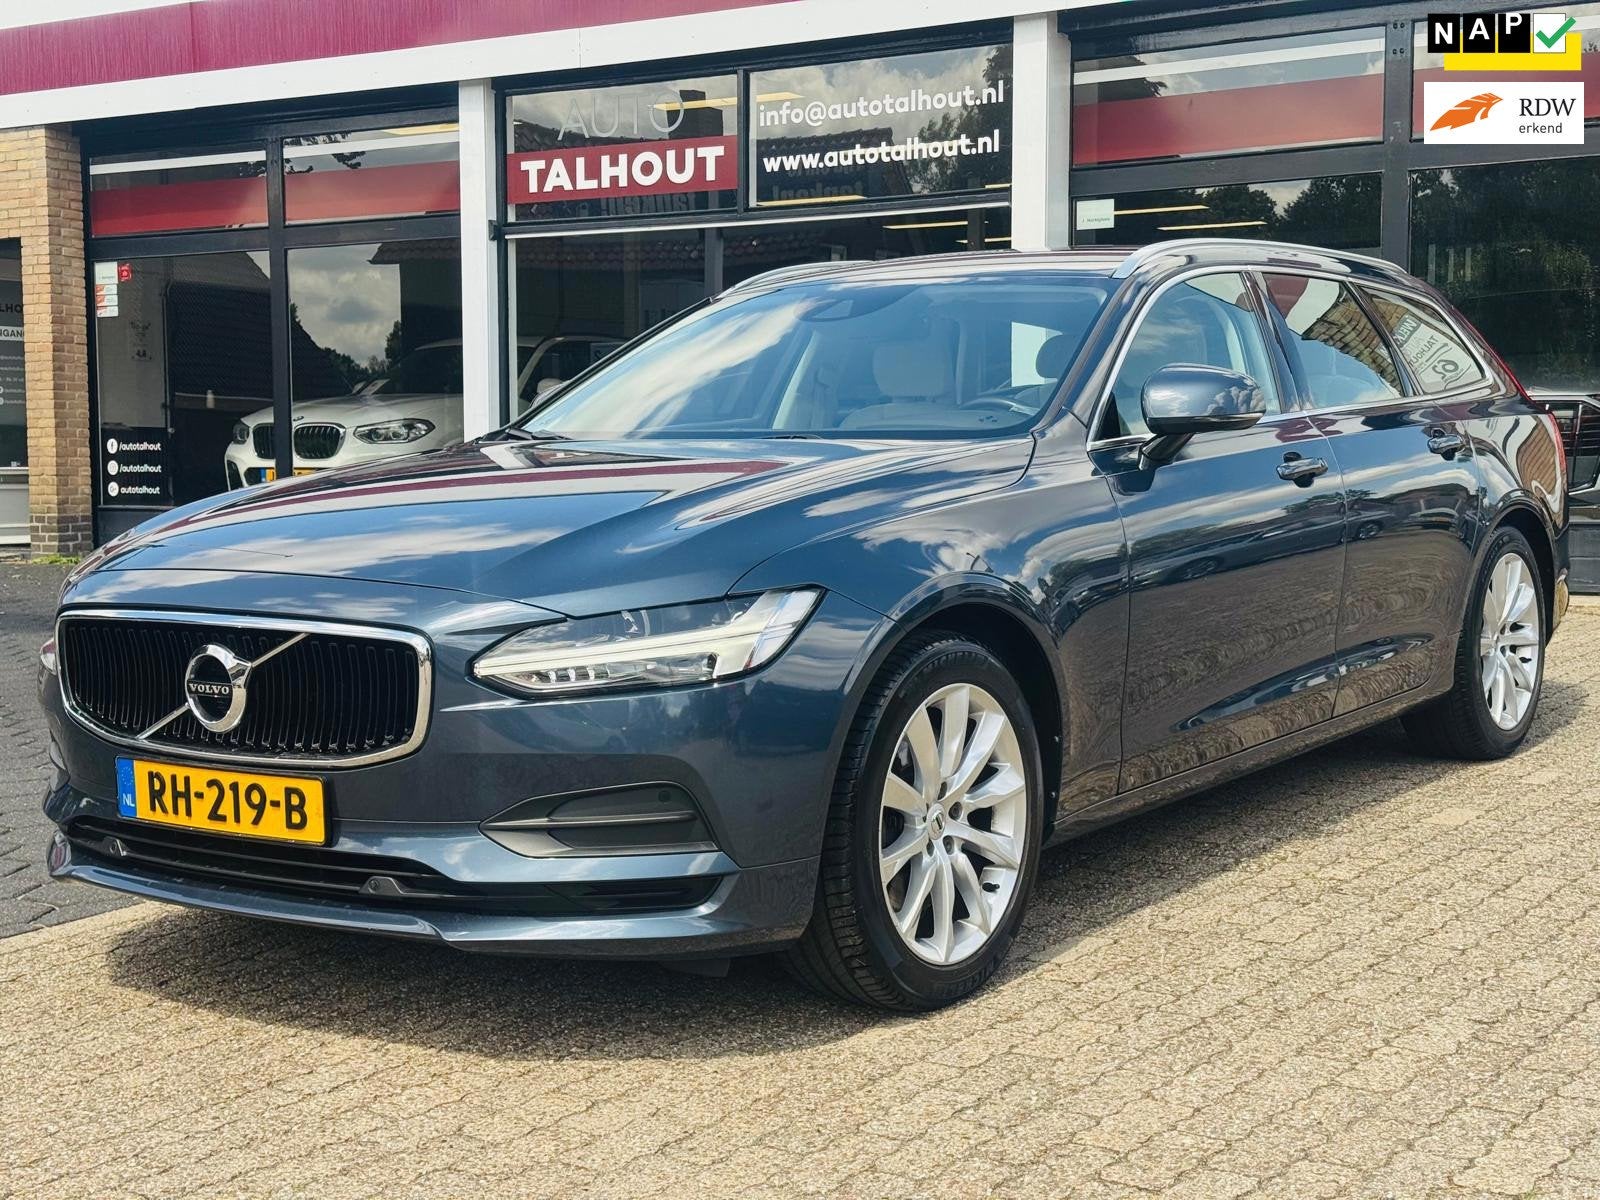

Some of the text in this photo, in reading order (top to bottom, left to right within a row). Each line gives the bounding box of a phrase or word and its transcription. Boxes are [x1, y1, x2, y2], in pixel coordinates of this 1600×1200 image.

[557, 89, 685, 142] AUTO
[758, 79, 1005, 128] info@autotalhout.nl
[520, 145, 725, 194] TALHOUT
[762, 129, 1000, 174] www.autotalhout.nl
[120, 485, 161, 495] autotalhout
[188, 682, 230, 695] VOLVO
[122, 770, 308, 831] NL RH-219-B
